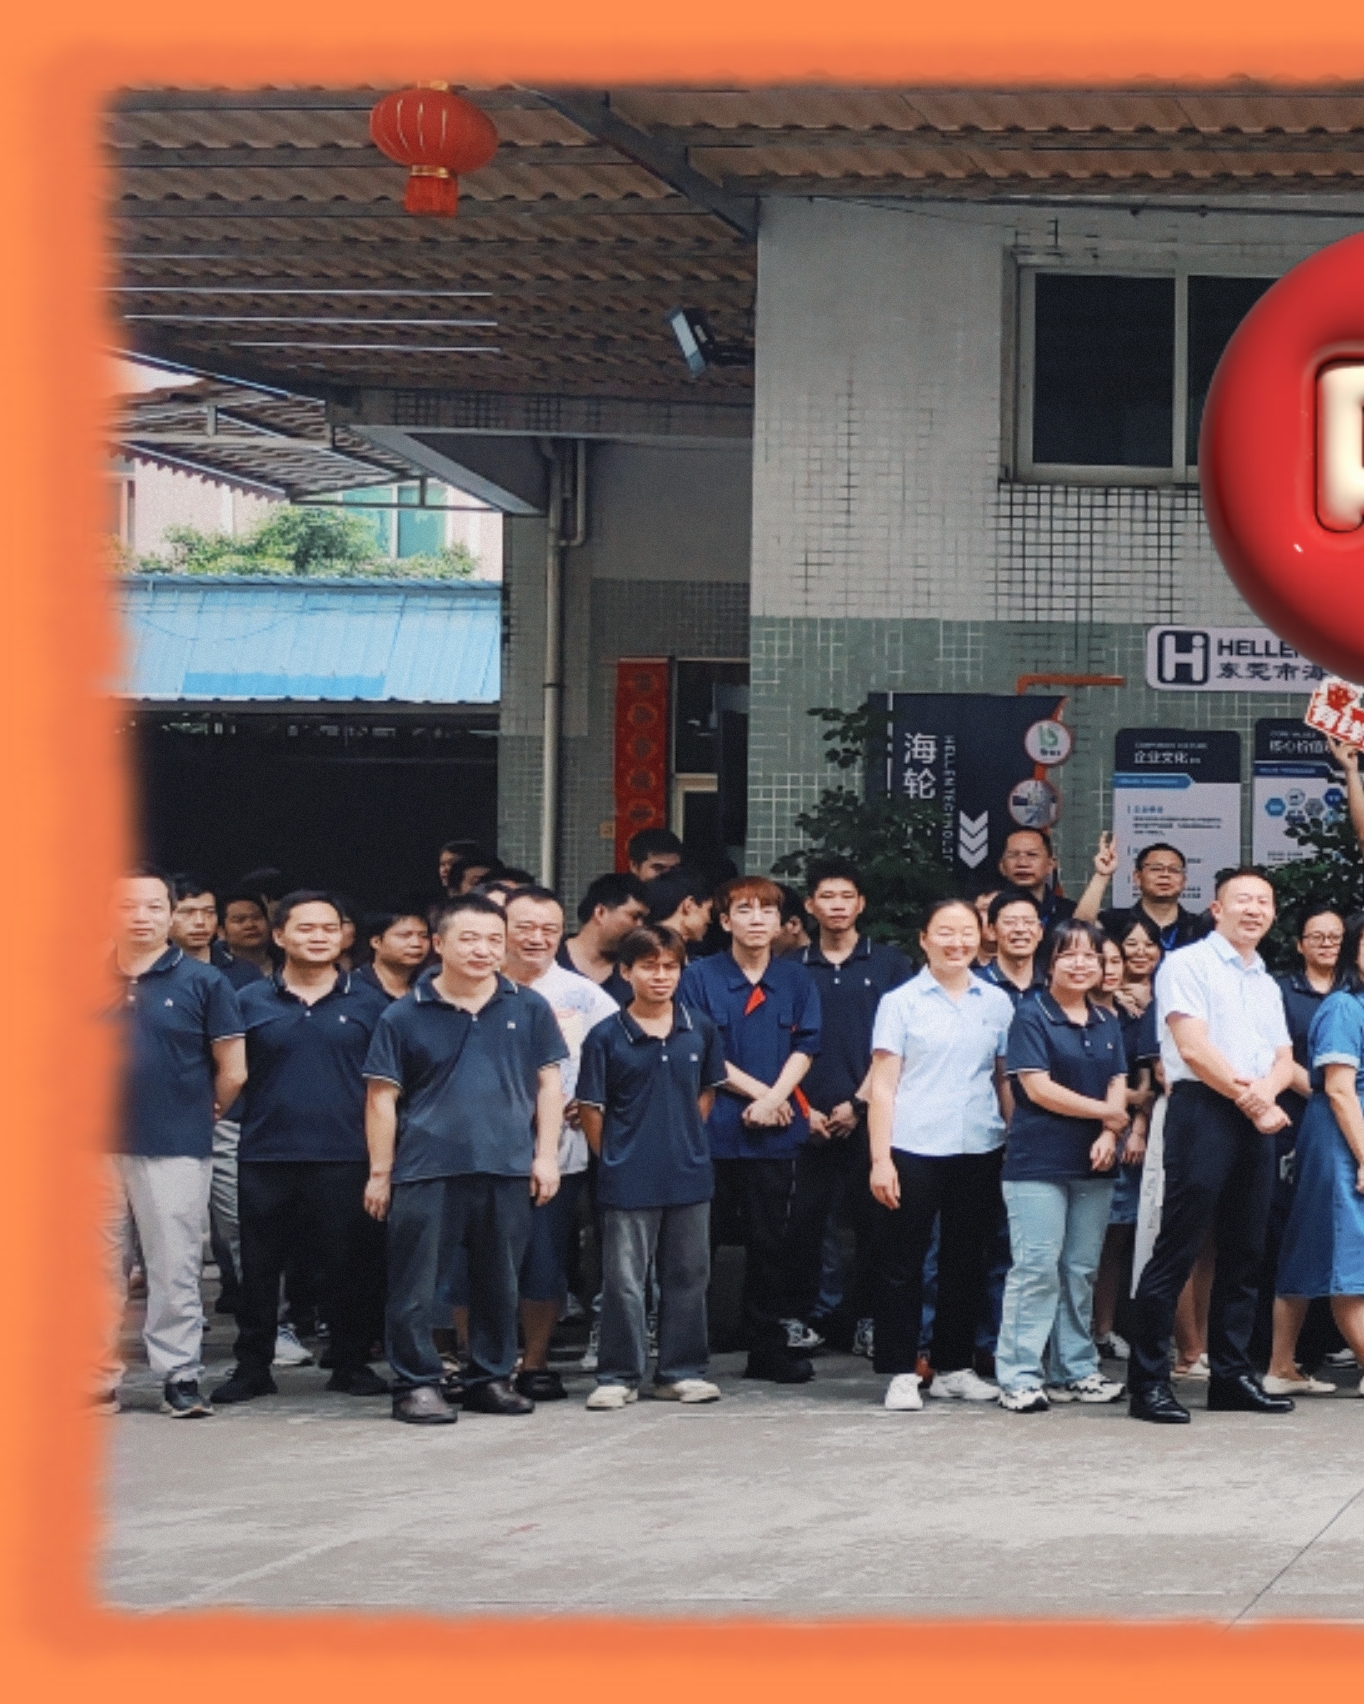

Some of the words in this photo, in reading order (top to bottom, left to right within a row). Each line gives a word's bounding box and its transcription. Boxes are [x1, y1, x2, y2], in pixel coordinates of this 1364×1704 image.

[903, 732, 938, 799] 海轮
[1134, 750, 1189, 765] 企业文化
